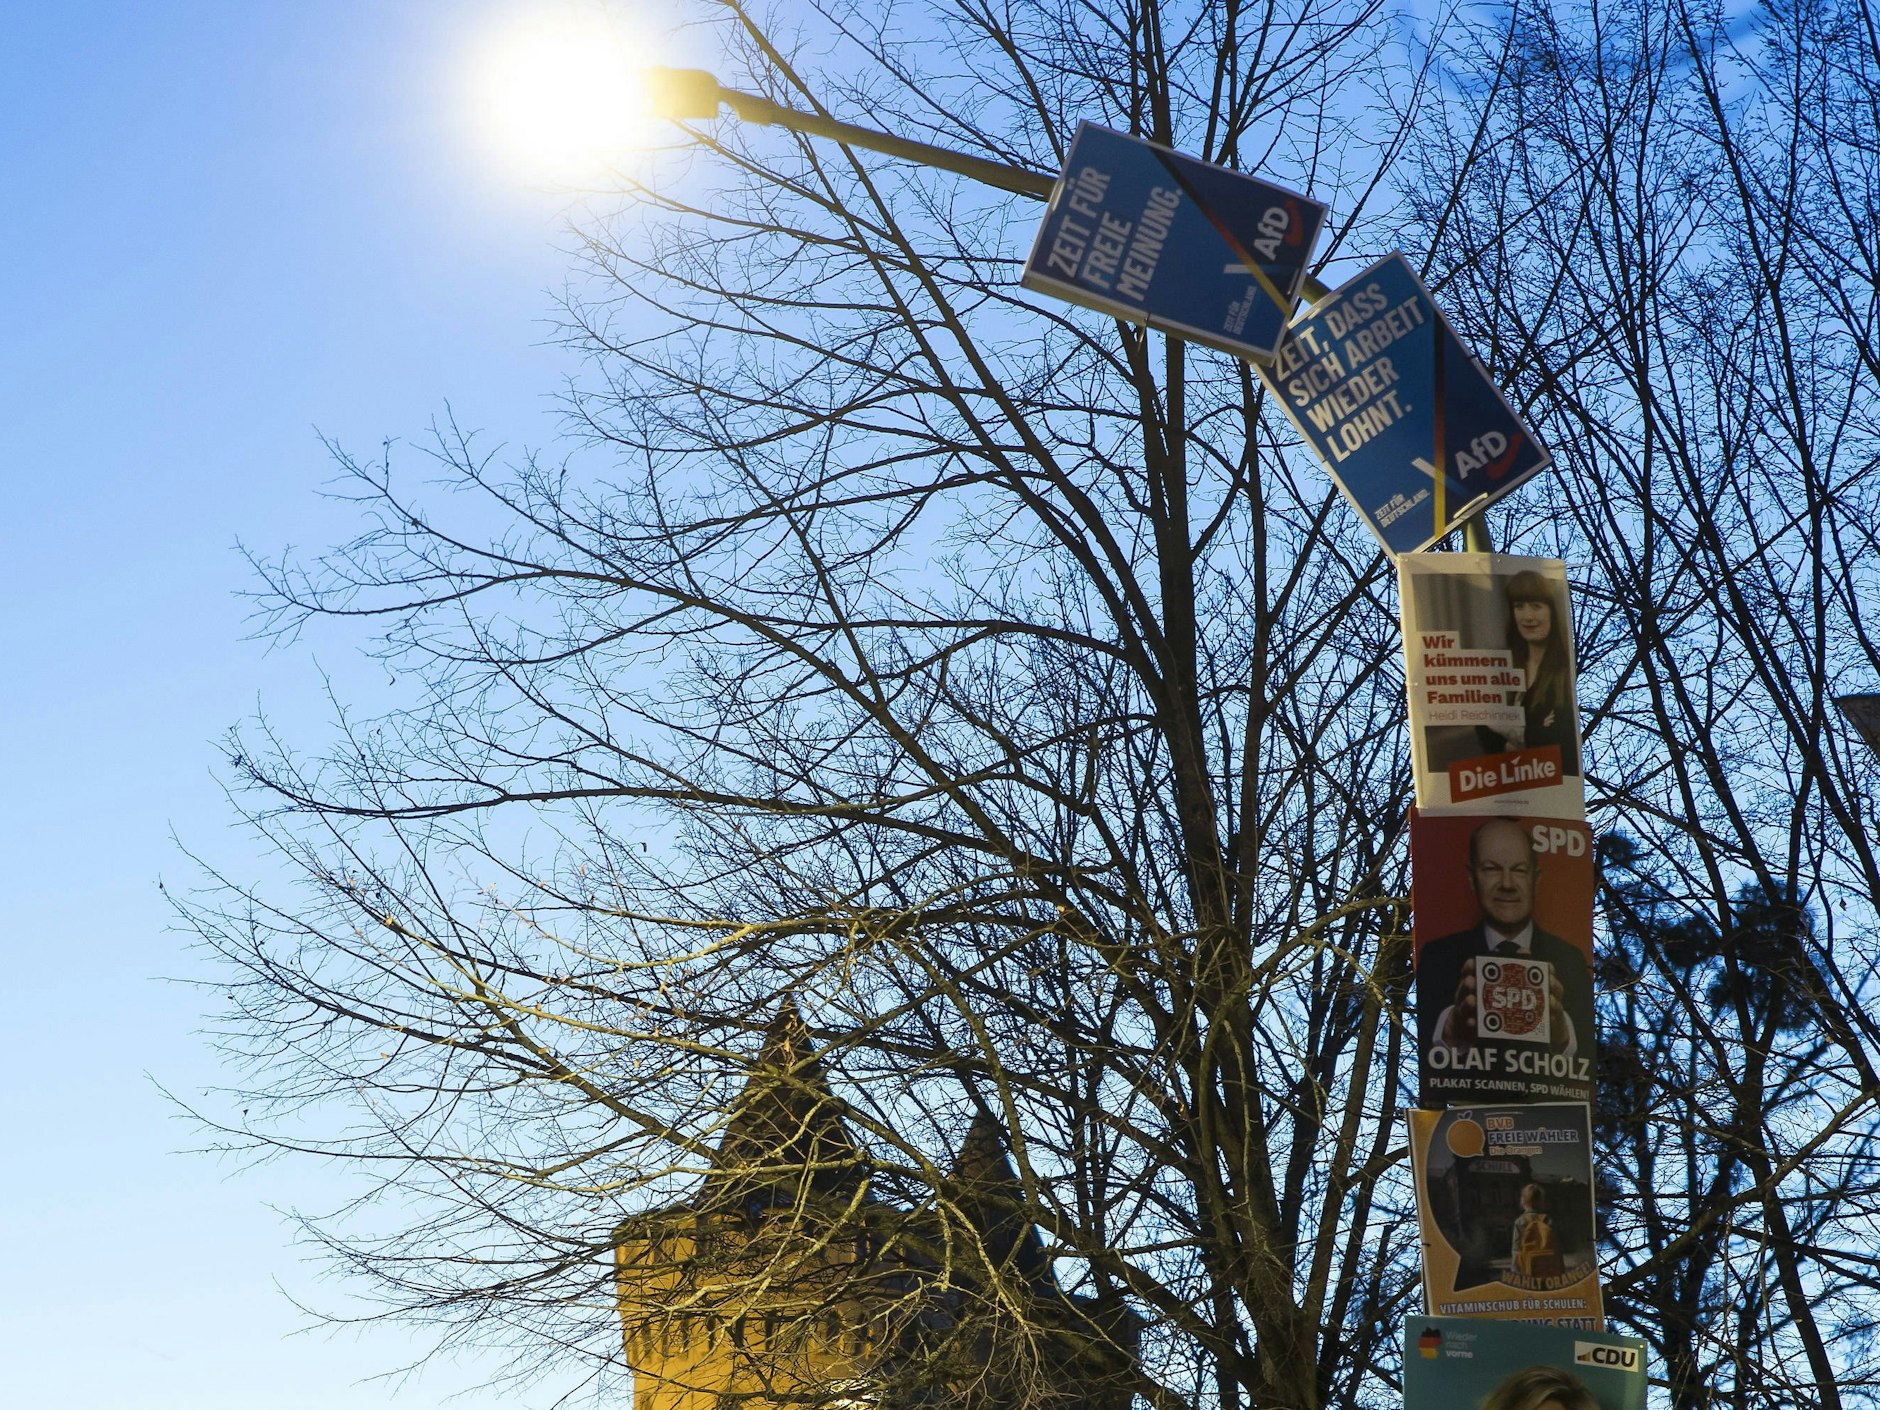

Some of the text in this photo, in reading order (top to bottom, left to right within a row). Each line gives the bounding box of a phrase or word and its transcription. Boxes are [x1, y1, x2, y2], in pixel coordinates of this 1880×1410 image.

[1048, 166, 1111, 278] ZEIT FÜR
[1253, 206, 1291, 261] AfD
[1081, 211, 1132, 290] FREIE
[1116, 186, 1183, 302] MEINUNG.
[1275, 283, 1388, 382] ZEIT, DASS
[1289, 296, 1425, 407] SICH ARBEIT
[1306, 357, 1400, 434] WIEDER
[1326, 390, 1413, 463] LOHNT.
[1454, 431, 1508, 480] AfD
[1422, 635, 1455, 649] Wir
[1424, 654, 1508, 668] kümmern
[1426, 672, 1521, 686] uns um alle
[1427, 690, 1503, 704] Familien
[1459, 756, 1556, 792] Die Linke
[1532, 825, 1586, 858] SPD
[1492, 987, 1537, 1010] SPD
[1428, 1046, 1590, 1081] OLAF SCHOLZ
[1430, 1078, 1590, 1100] PLAKAT SCANNEN, SPD WÄHLEN!
[1487, 1118, 1514, 1130] BVB
[1488, 1128, 1579, 1144] FREIE WÄHLER
[1440, 1299, 1587, 1314] VITAMINSCHUB FÜR SCHULEN:
[1592, 1348, 1636, 1367] CDU
